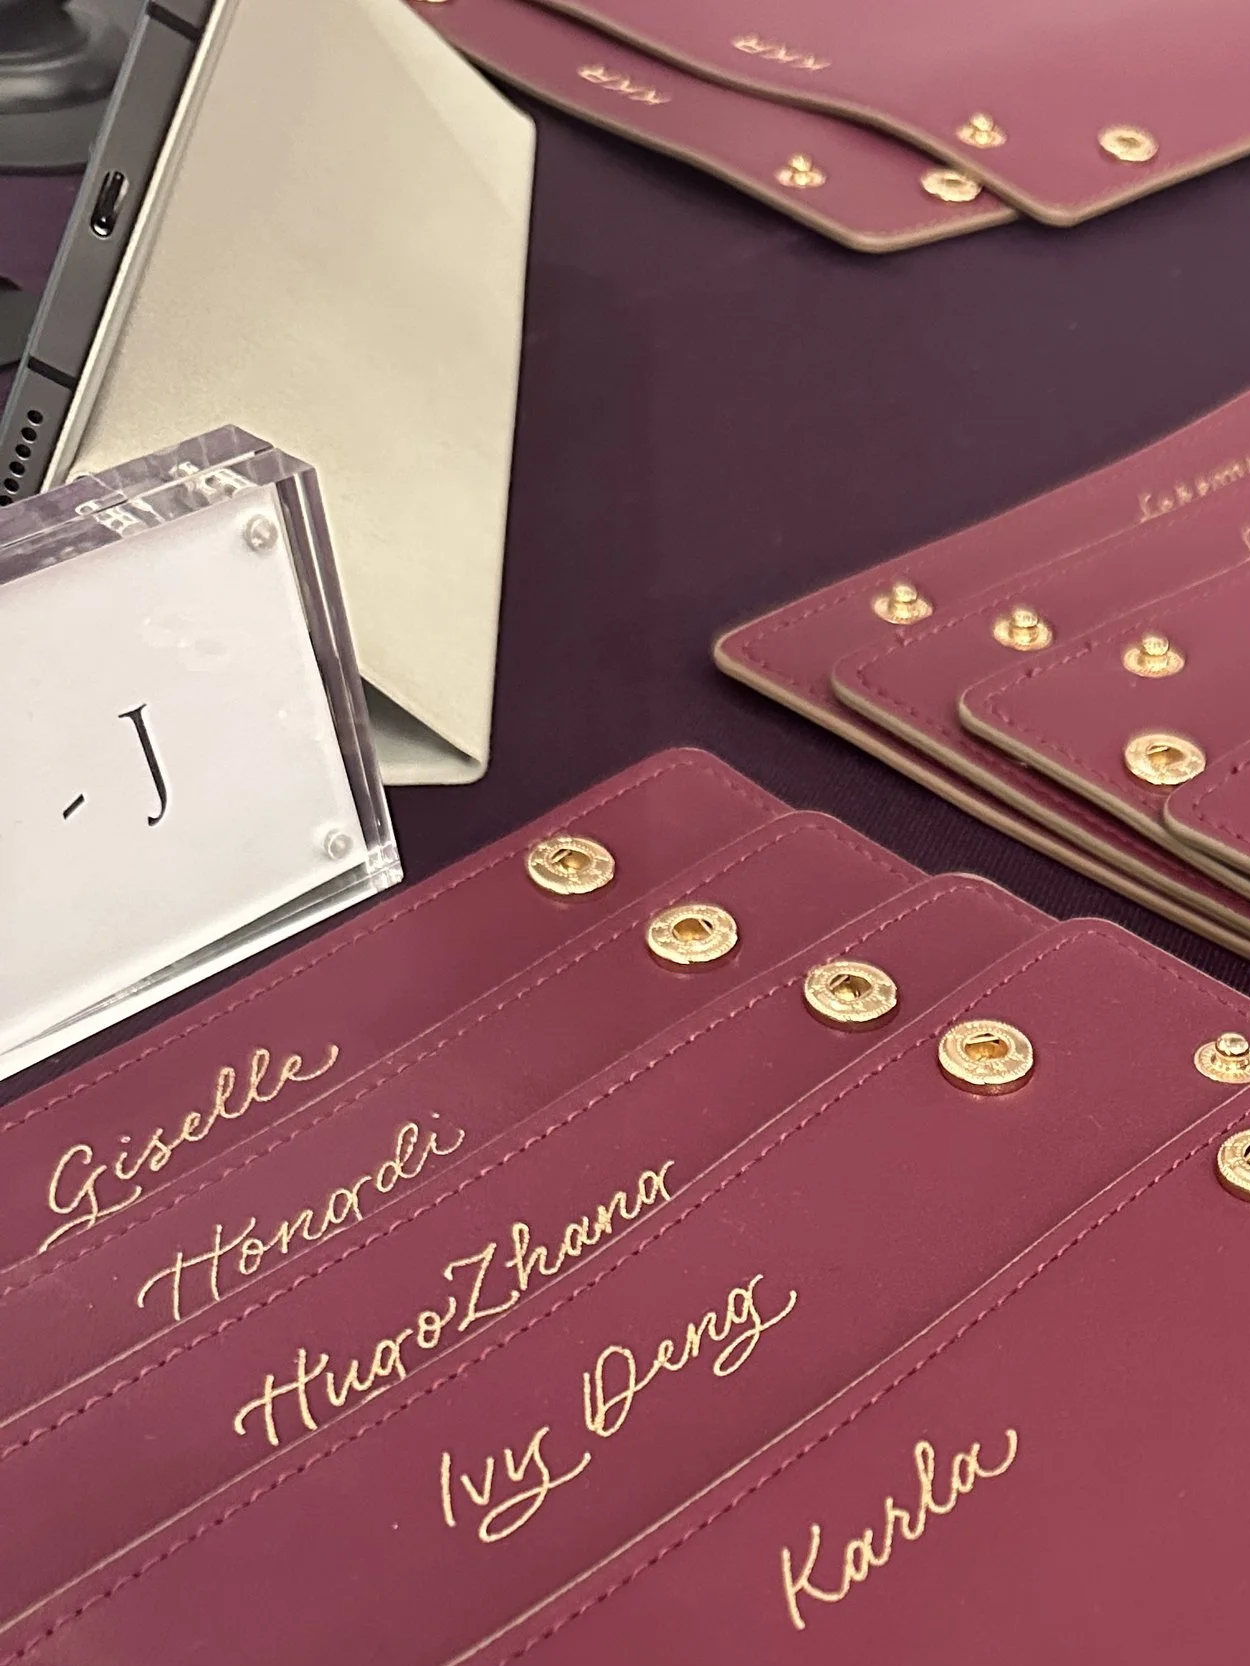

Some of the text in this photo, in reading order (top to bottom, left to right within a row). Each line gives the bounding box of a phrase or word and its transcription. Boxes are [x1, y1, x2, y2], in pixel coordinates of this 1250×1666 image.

[118, 703, 168, 828] J
[38, 1044, 340, 1254] Giselle
[440, 1274, 798, 1543] Ivy Deng
[781, 1429, 1018, 1631] Karla
